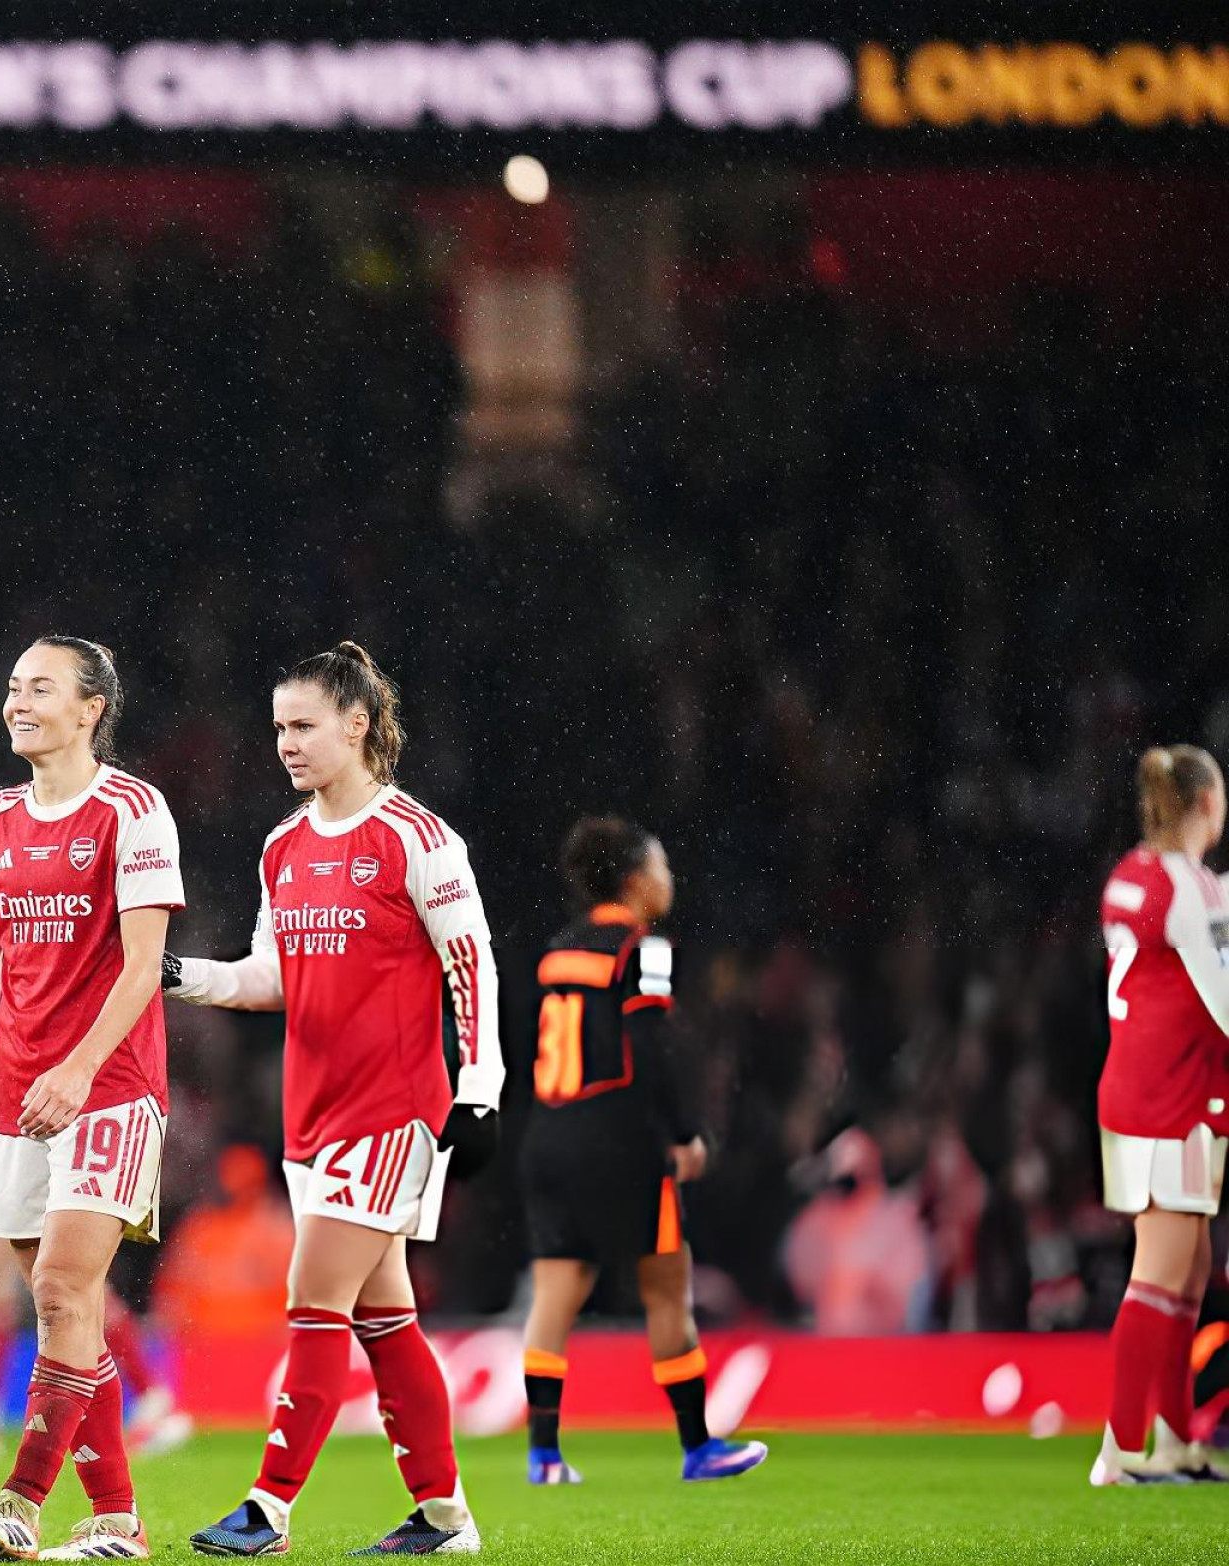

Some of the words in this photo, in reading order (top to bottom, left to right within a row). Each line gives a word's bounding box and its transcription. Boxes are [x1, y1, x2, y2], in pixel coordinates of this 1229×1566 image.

[121, 39, 662, 130] CHAMPIONS
[665, 39, 851, 130] CUP
[856, 40, 1229, 128] LONDON
[133, 848, 161, 861] VISIT
[123, 858, 173, 875] RWANDA
[432, 879, 461, 895] VISIT
[426, 888, 471, 910] RWANDA
[272, 903, 366, 933] Emirates
[12, 922, 30, 944] FLY
[33, 921, 75, 943] BETTER
[304, 933, 347, 955] BETTER
[534, 992, 584, 1102] 31
[71, 1115, 123, 1174] 19
[325, 1133, 382, 1186] 21
